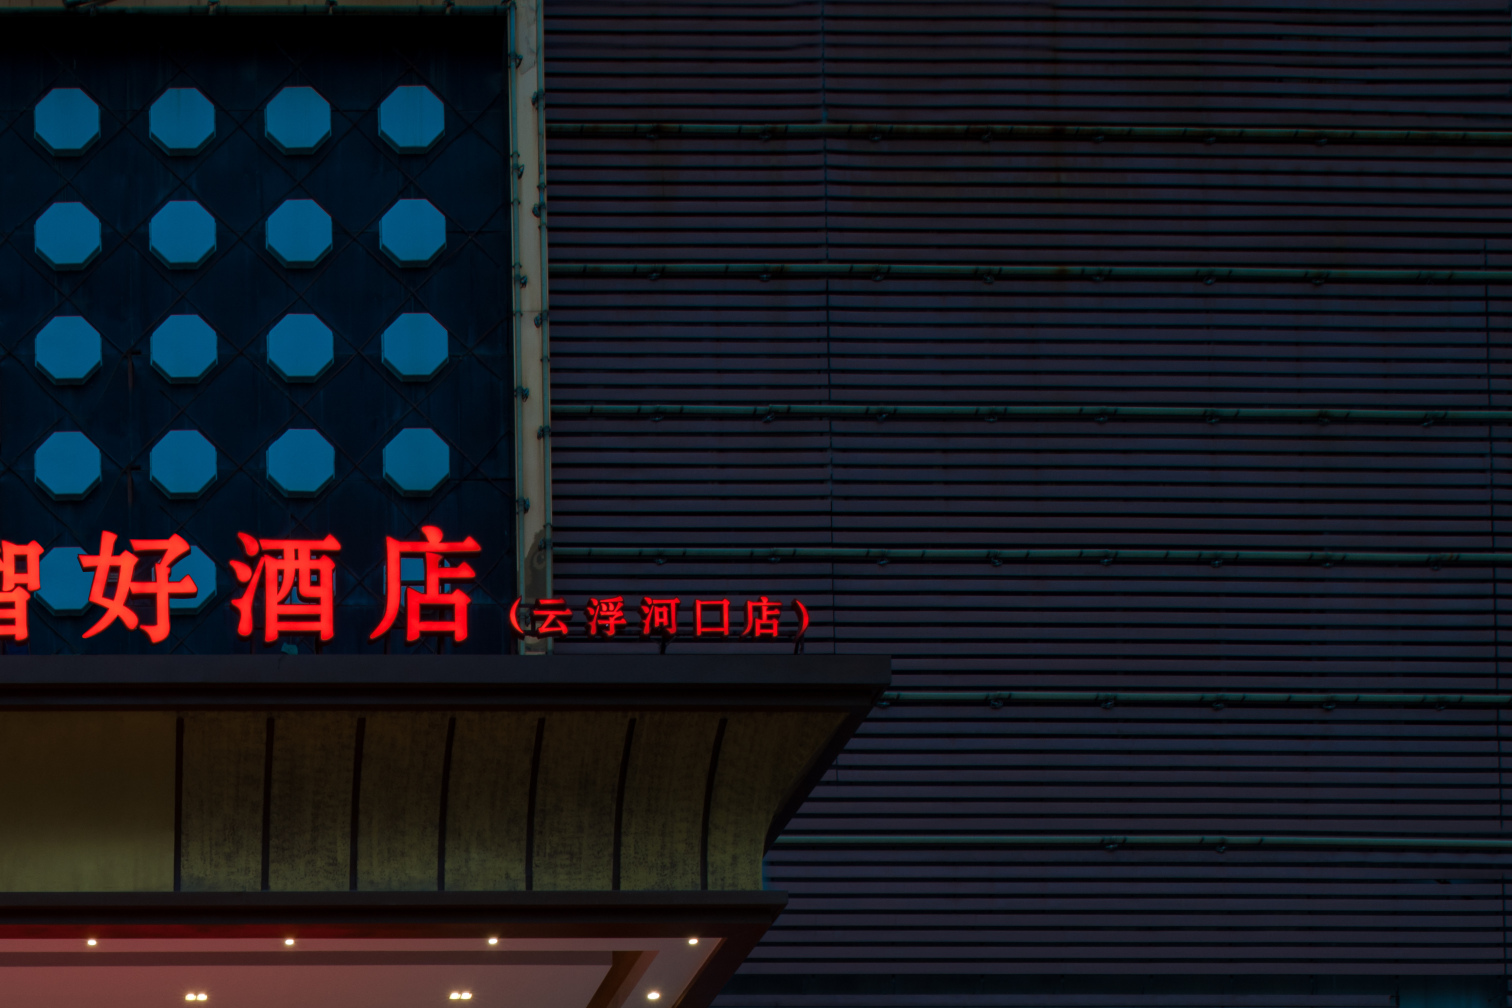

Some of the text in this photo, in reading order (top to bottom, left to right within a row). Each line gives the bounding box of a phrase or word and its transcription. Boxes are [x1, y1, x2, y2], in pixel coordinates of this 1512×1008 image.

[509, 595, 810, 637] （云浮河口店）
